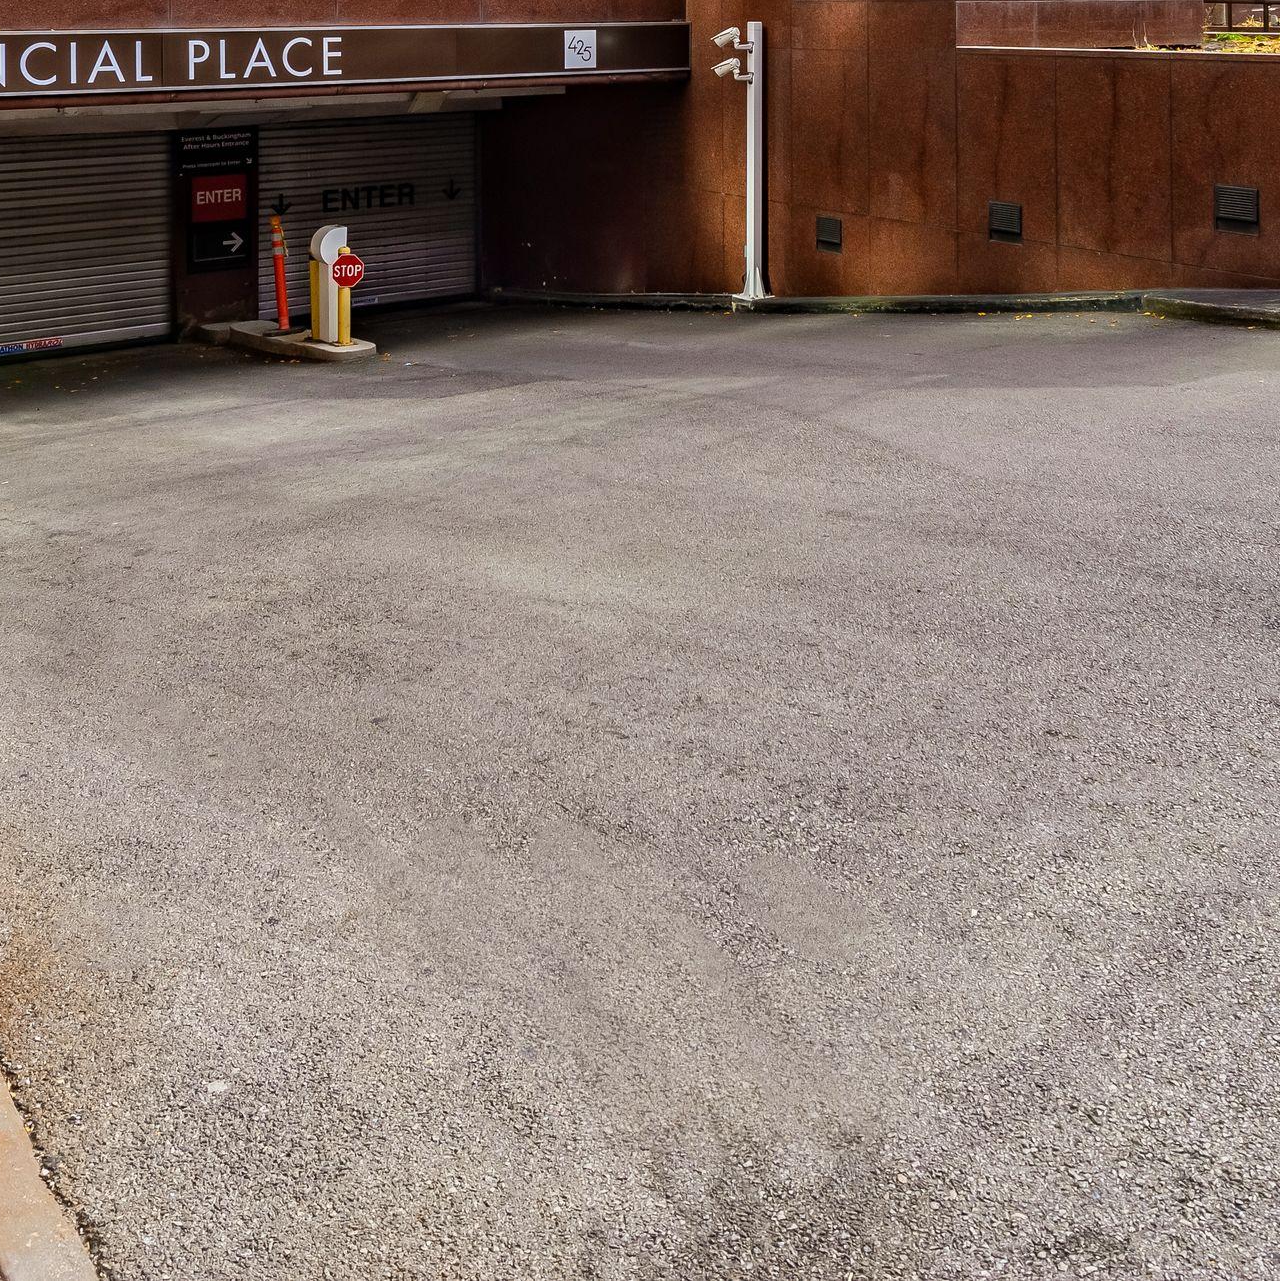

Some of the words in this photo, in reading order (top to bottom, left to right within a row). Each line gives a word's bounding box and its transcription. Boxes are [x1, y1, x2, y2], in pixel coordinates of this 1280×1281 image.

[188, 36, 343, 81] PLACE
[568, 35, 592, 62] 425
[196, 188, 242, 206] ENTER
[322, 183, 416, 213] ENTER
[333, 264, 362, 278] STOP
